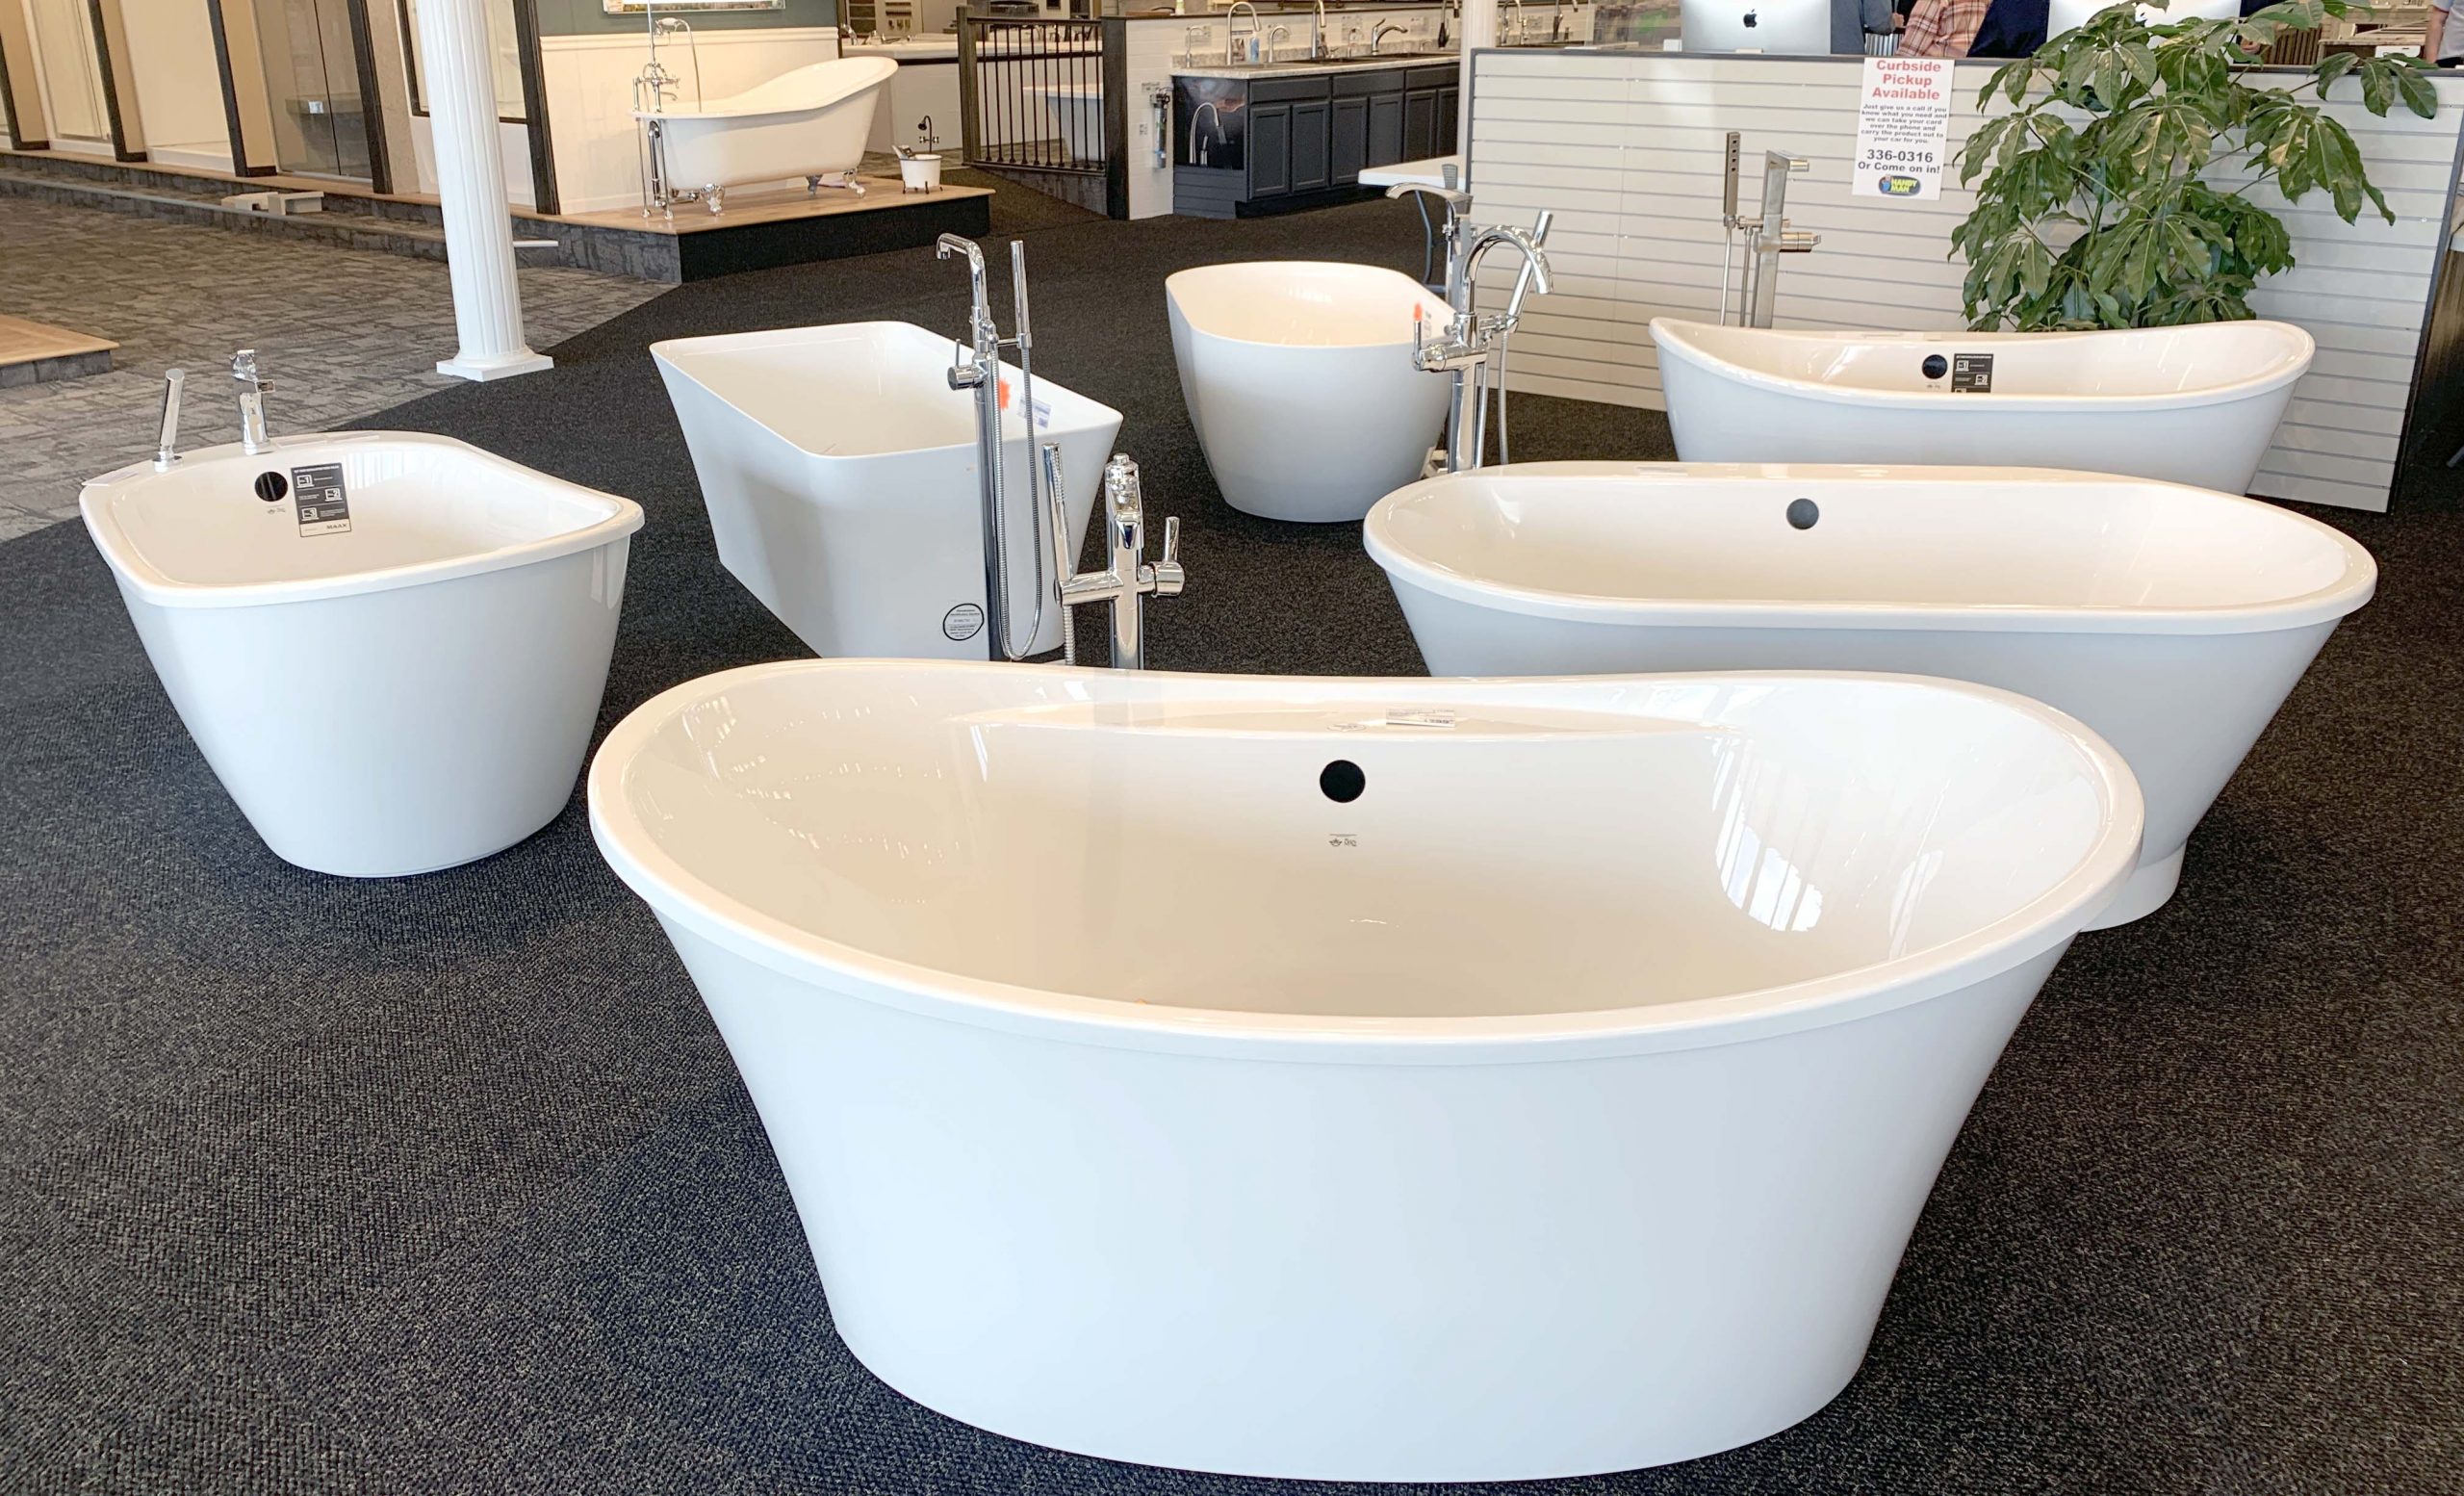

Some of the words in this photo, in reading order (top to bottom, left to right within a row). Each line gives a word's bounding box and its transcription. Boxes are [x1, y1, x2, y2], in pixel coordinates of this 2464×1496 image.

[1876, 60, 1941, 72] Curbside
[1883, 74, 1932, 88] Pickup
[1872, 87, 1940, 100] Available
[1867, 149, 1933, 163] 336-0316
[1858, 161, 1871, 169] Or
[1874, 162, 1906, 171] Come
[1926, 165, 1940, 173] in!
